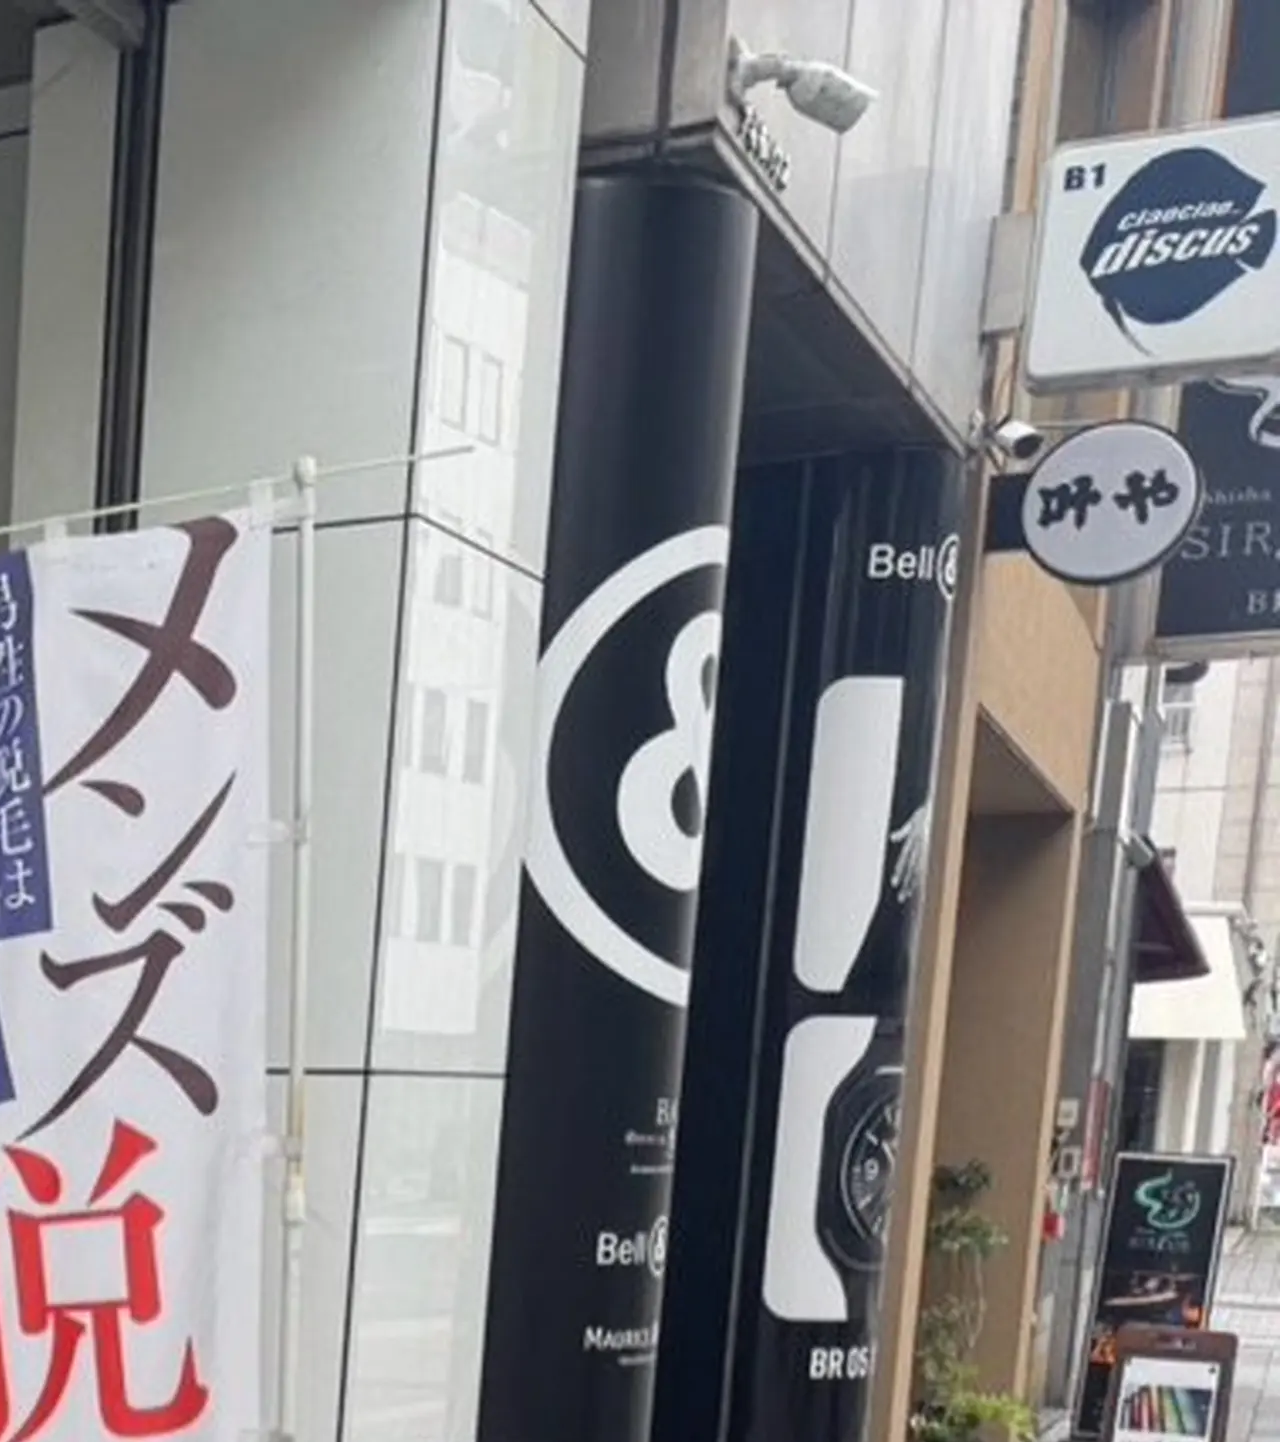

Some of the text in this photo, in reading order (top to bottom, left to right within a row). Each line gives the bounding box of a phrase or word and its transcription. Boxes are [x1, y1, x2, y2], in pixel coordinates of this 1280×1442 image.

[1065, 163, 1107, 191] B1
[1091, 223, 1261, 279] discus
[868, 545, 936, 579] Bell
[12, 515, 239, 1141] メンズ
[596, 1231, 646, 1266] Bell
[810, 1346, 842, 1380] BR
